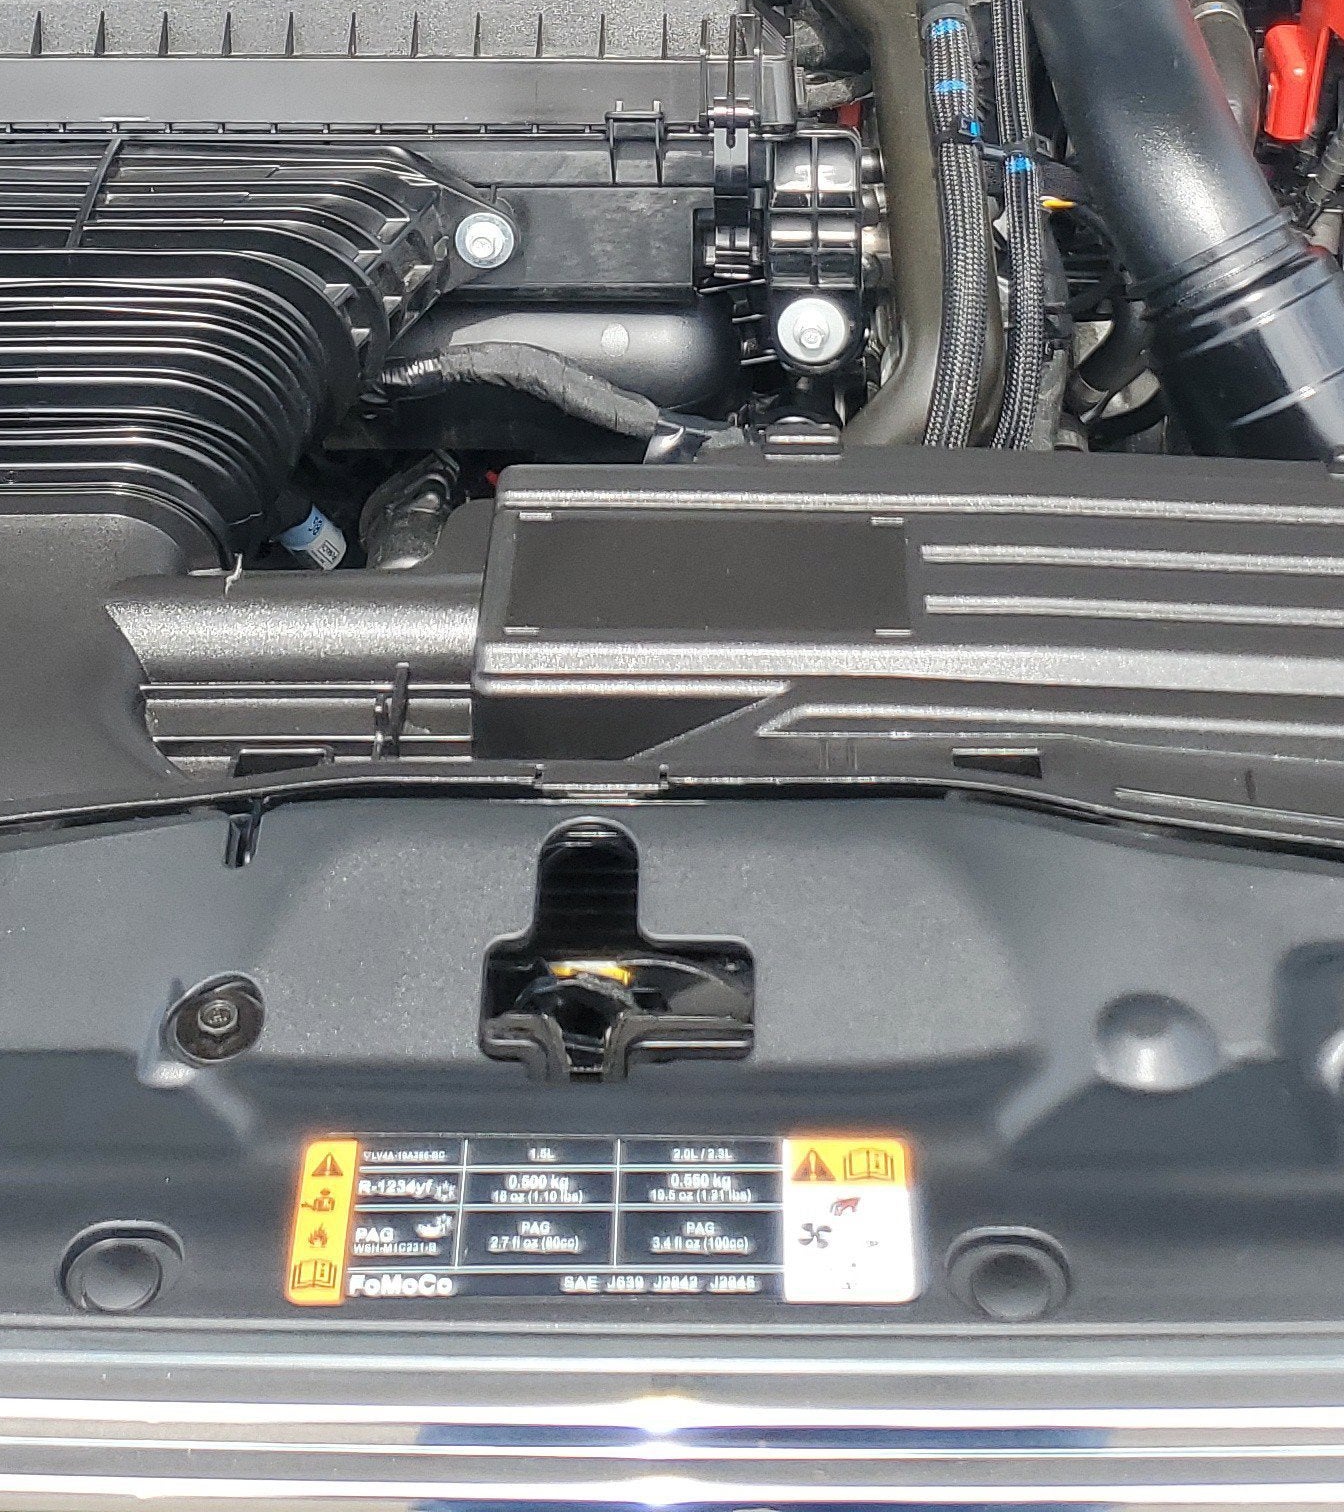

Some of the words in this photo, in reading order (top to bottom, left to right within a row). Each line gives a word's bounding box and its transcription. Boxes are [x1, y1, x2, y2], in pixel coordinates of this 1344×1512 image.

[529, 1148, 555, 1160] 1.5L
[673, 1148, 699, 1160] 2.0L
[708, 1148, 733, 1160] 2.3L
[358, 1178, 433, 1196] R-1234yf
[508, 1174, 548, 1189] 0.500
[550, 1174, 570, 1192] kg
[670, 1173, 710, 1188] 0.550
[712, 1173, 732, 1191] kg
[521, 1221, 550, 1235] PAG
[686, 1221, 715, 1234] PAG
[356, 1227, 395, 1243] PAG
[489, 1236, 509, 1249] 2.7
[522, 1238, 539, 1249] oz
[685, 1239, 701, 1249] oz
[349, 1273, 453, 1296] FoMoCo
[563, 1275, 599, 1289] SAE
[606, 1275, 645, 1289] J639
